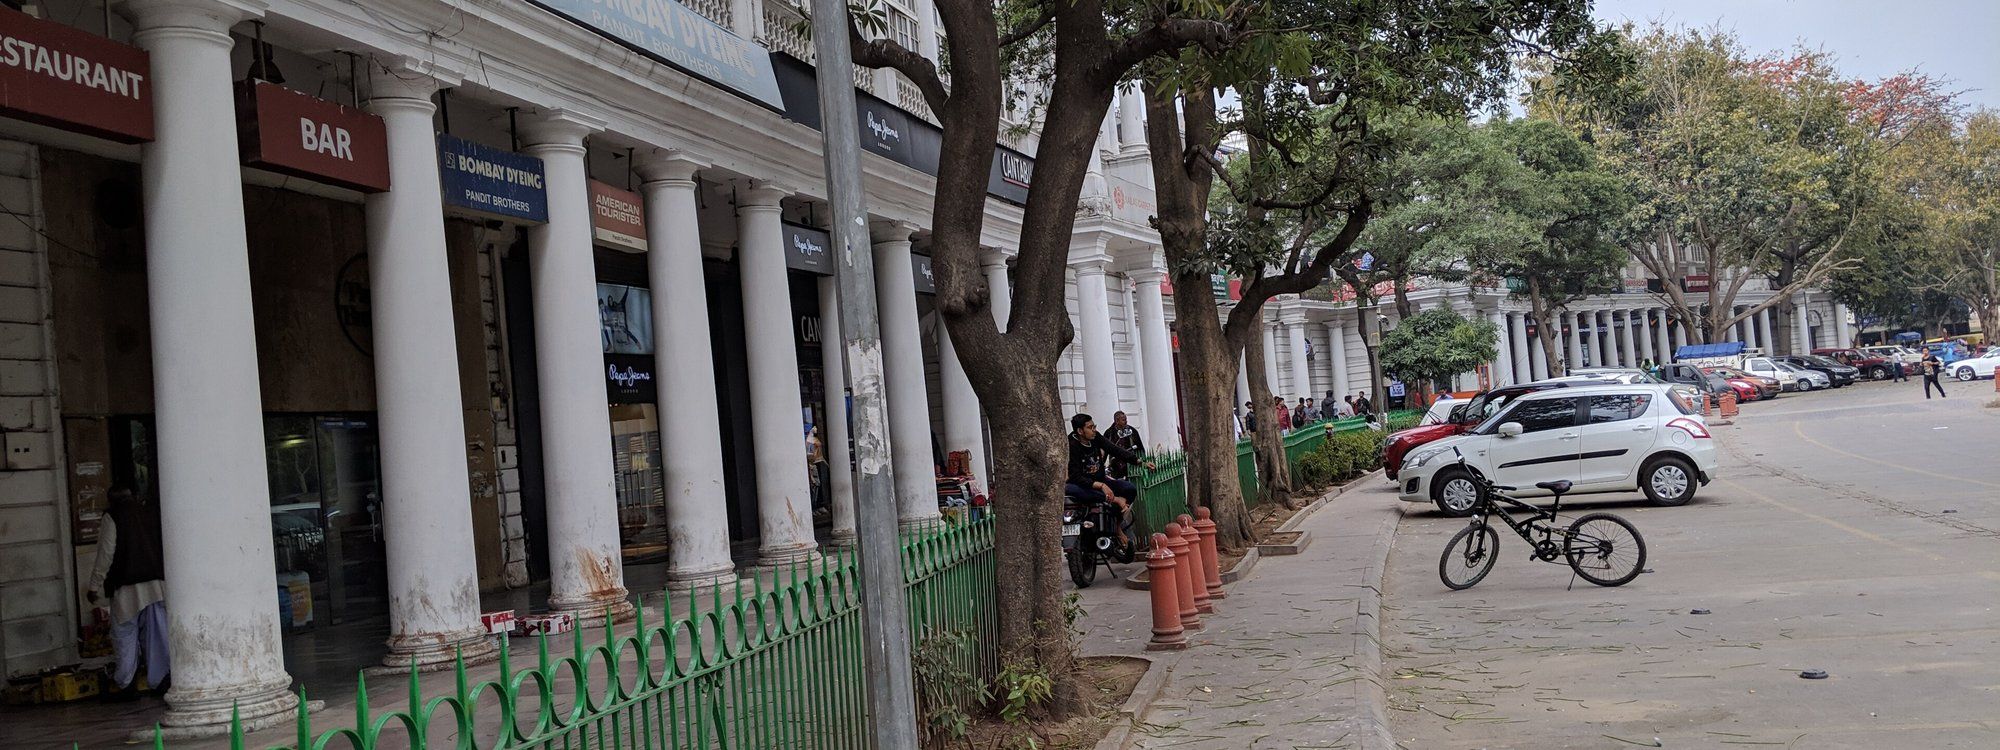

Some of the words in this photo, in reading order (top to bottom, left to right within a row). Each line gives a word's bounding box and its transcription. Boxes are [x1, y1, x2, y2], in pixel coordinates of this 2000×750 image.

[592, 9, 645, 45] PANDIT
[652, 37, 723, 80] BROTHERS
[678, 10, 758, 78] DYEING
[300, 117, 354, 161] BAR
[866, 110, 883, 137] Pepe
[881, 118, 899, 140] Jeans
[458, 154, 505, 181] BOMBAY
[506, 166, 542, 189] DYEING
[1002, 152, 1034, 185] CANTABI
[465, 189, 492, 204] PANDIT
[492, 195, 530, 212] BROTHERS
[595, 193, 640, 216] AMERICAN
[595, 204, 641, 225] TOURISTER
[793, 234, 807, 254] Pepe
[805, 238, 823, 256] Jeans
[609, 363, 629, 387] Pepe
[627, 366, 651, 387] Jeans
